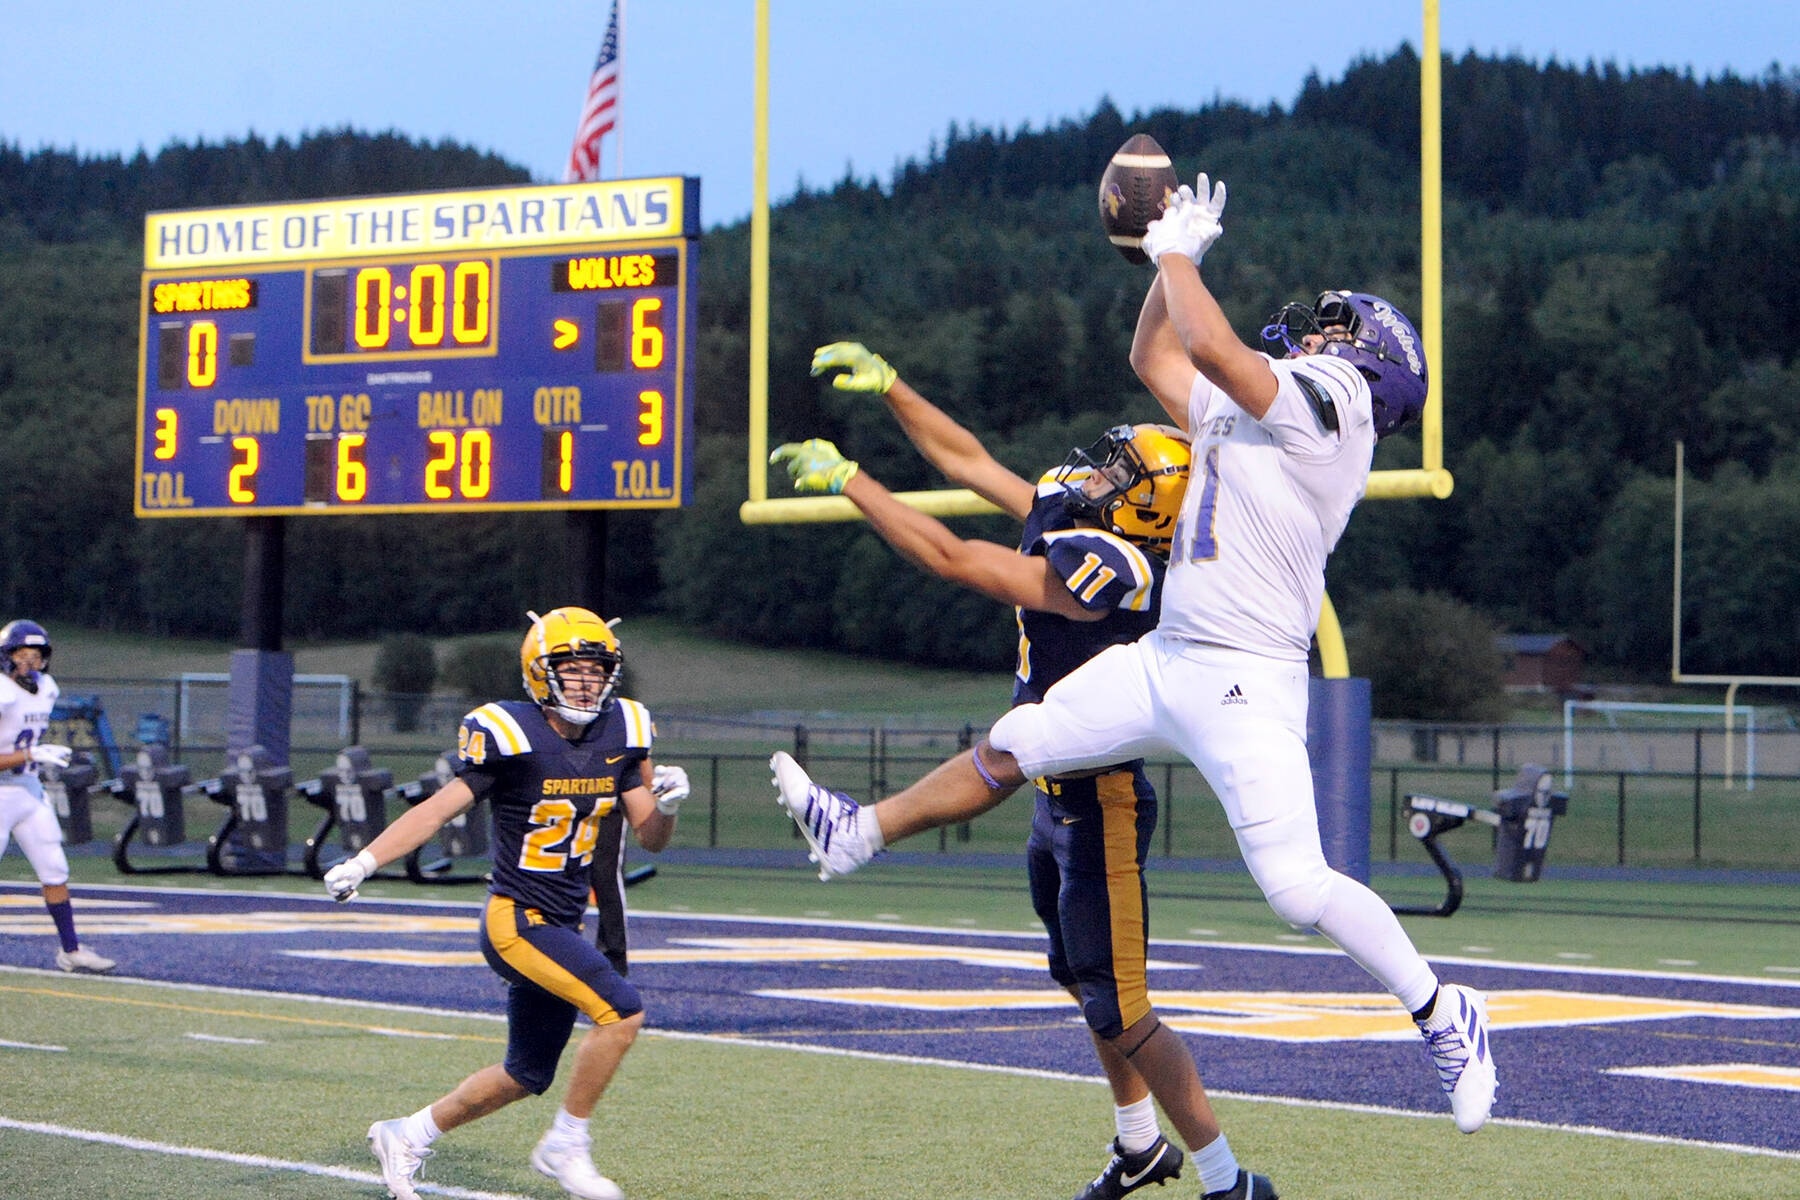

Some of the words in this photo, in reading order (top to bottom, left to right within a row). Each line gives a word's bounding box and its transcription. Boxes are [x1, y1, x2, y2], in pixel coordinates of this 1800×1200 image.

[159, 219, 269, 257] HOME
[283, 214, 330, 249] OF
[345, 208, 420, 245] THE
[434, 189, 669, 239] SPARTANS
[567, 254, 656, 290] WOLVES
[354, 260, 490, 348] 0:00
[187, 321, 217, 387] 0
[631, 297, 664, 368] 6
[213, 398, 280, 434] DOWN
[305, 395, 335, 432] TO
[417, 390, 469, 428] BALL
[472, 388, 503, 426] ON
[533, 386, 582, 426] QTR
[638, 390, 663, 446] 3
[154, 408, 178, 460] 3
[228, 437, 260, 503] 2
[336, 434, 367, 501] 6
[424, 429, 492, 499] 20
[559, 430, 573, 493] 1
[611, 459, 672, 498] T.O.L.
[1065, 551, 1117, 604] 11
[1220, 696, 1248, 706] adidas
[457, 725, 487, 765] 24
[541, 776, 615, 795] SPARTANS
